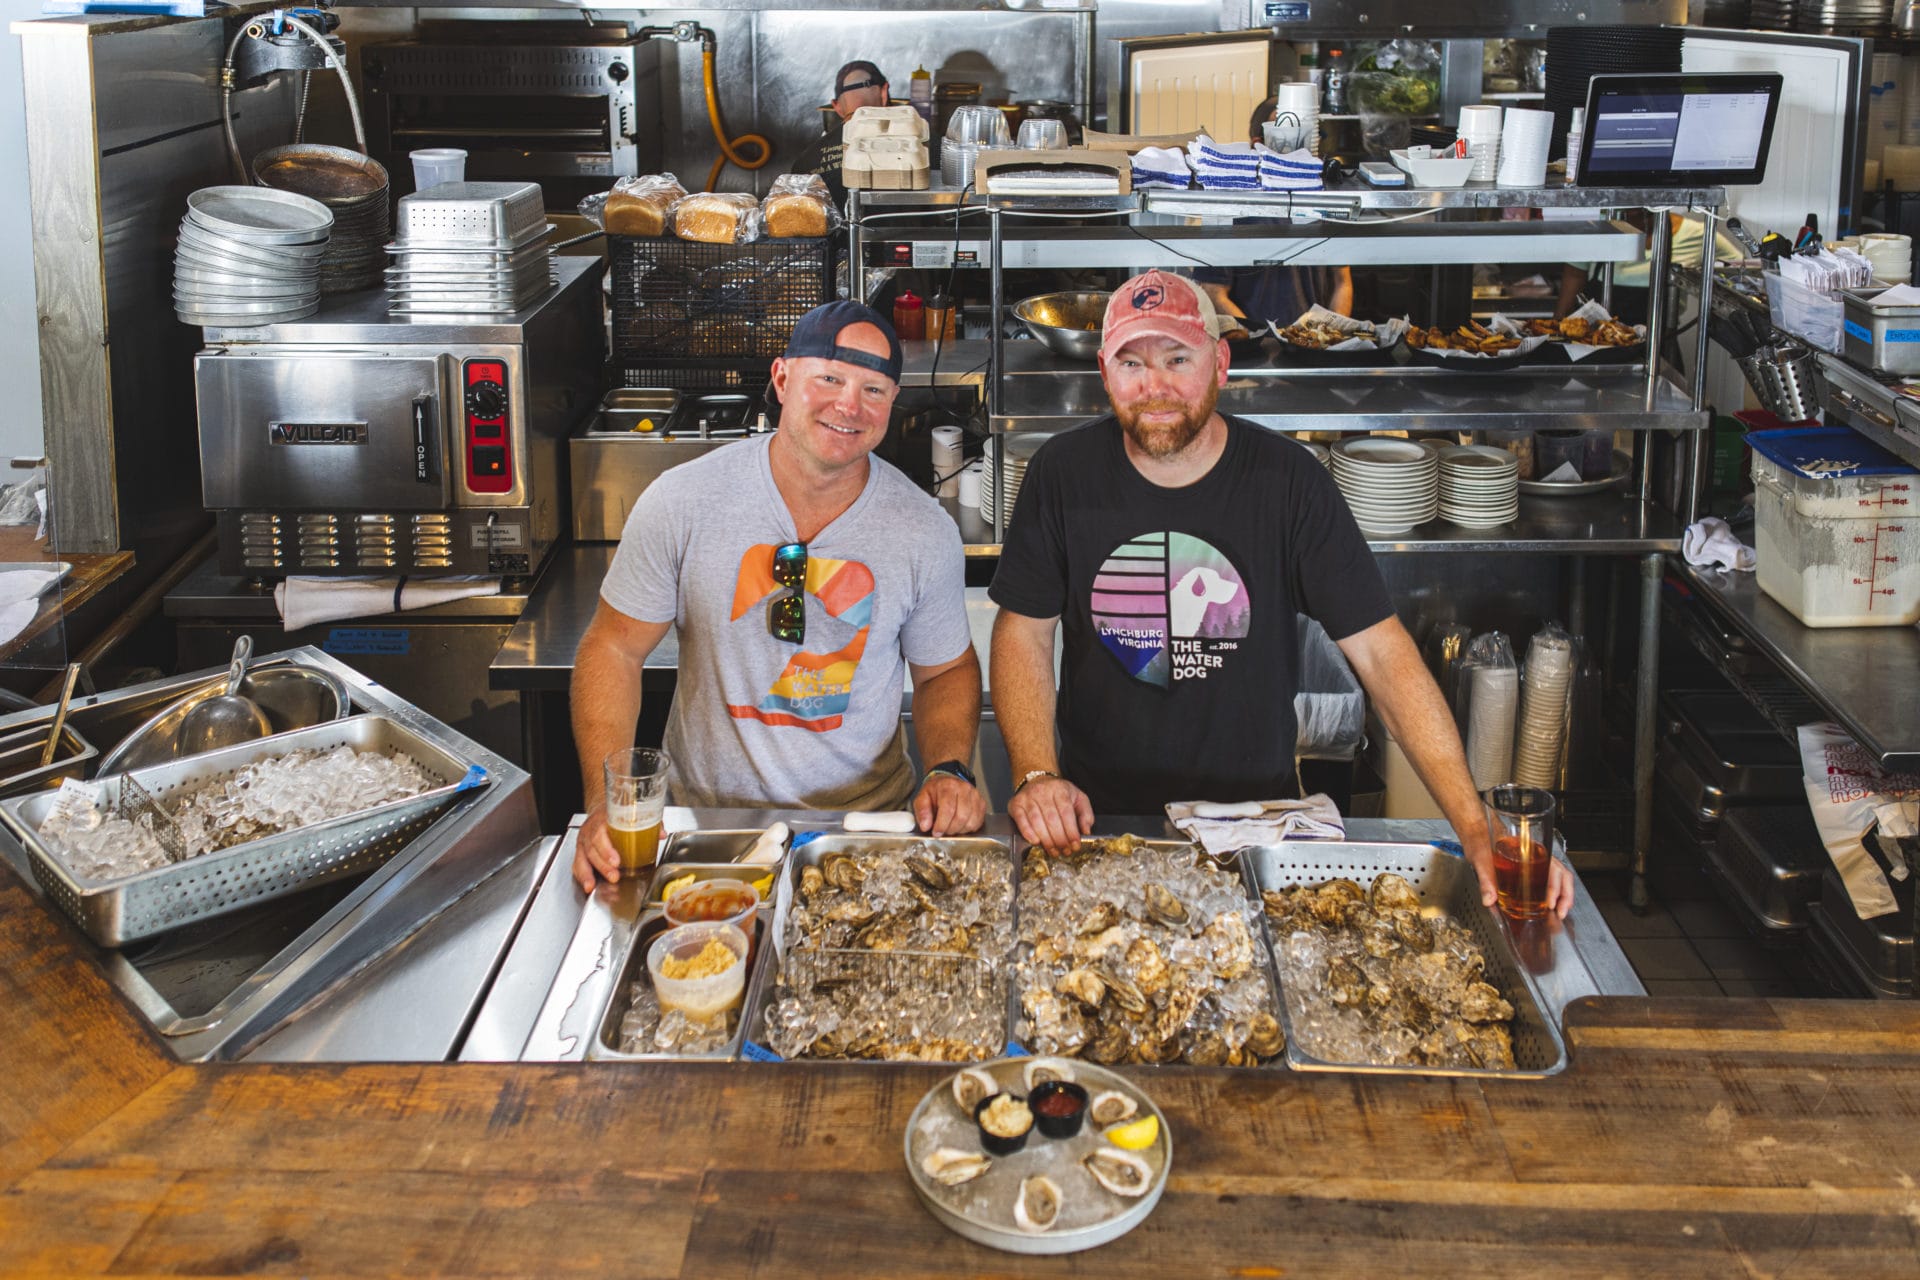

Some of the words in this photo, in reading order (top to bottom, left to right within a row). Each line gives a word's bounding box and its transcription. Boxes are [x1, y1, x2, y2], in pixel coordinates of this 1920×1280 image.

[280, 423, 357, 442] VULCAN
[417, 445, 426, 478] OPEN
[1101, 627, 1164, 638] LYNCHBURG
[1117, 638, 1165, 649] VIRGINIA
[1171, 640, 1202, 653] THE
[1219, 642, 1238, 650] 2016
[1171, 653, 1223, 668] WATER
[793, 665, 825, 681] THE
[1173, 667, 1207, 680] DOG
[792, 682, 843, 696] WATER
[790, 697, 824, 709] DOG
